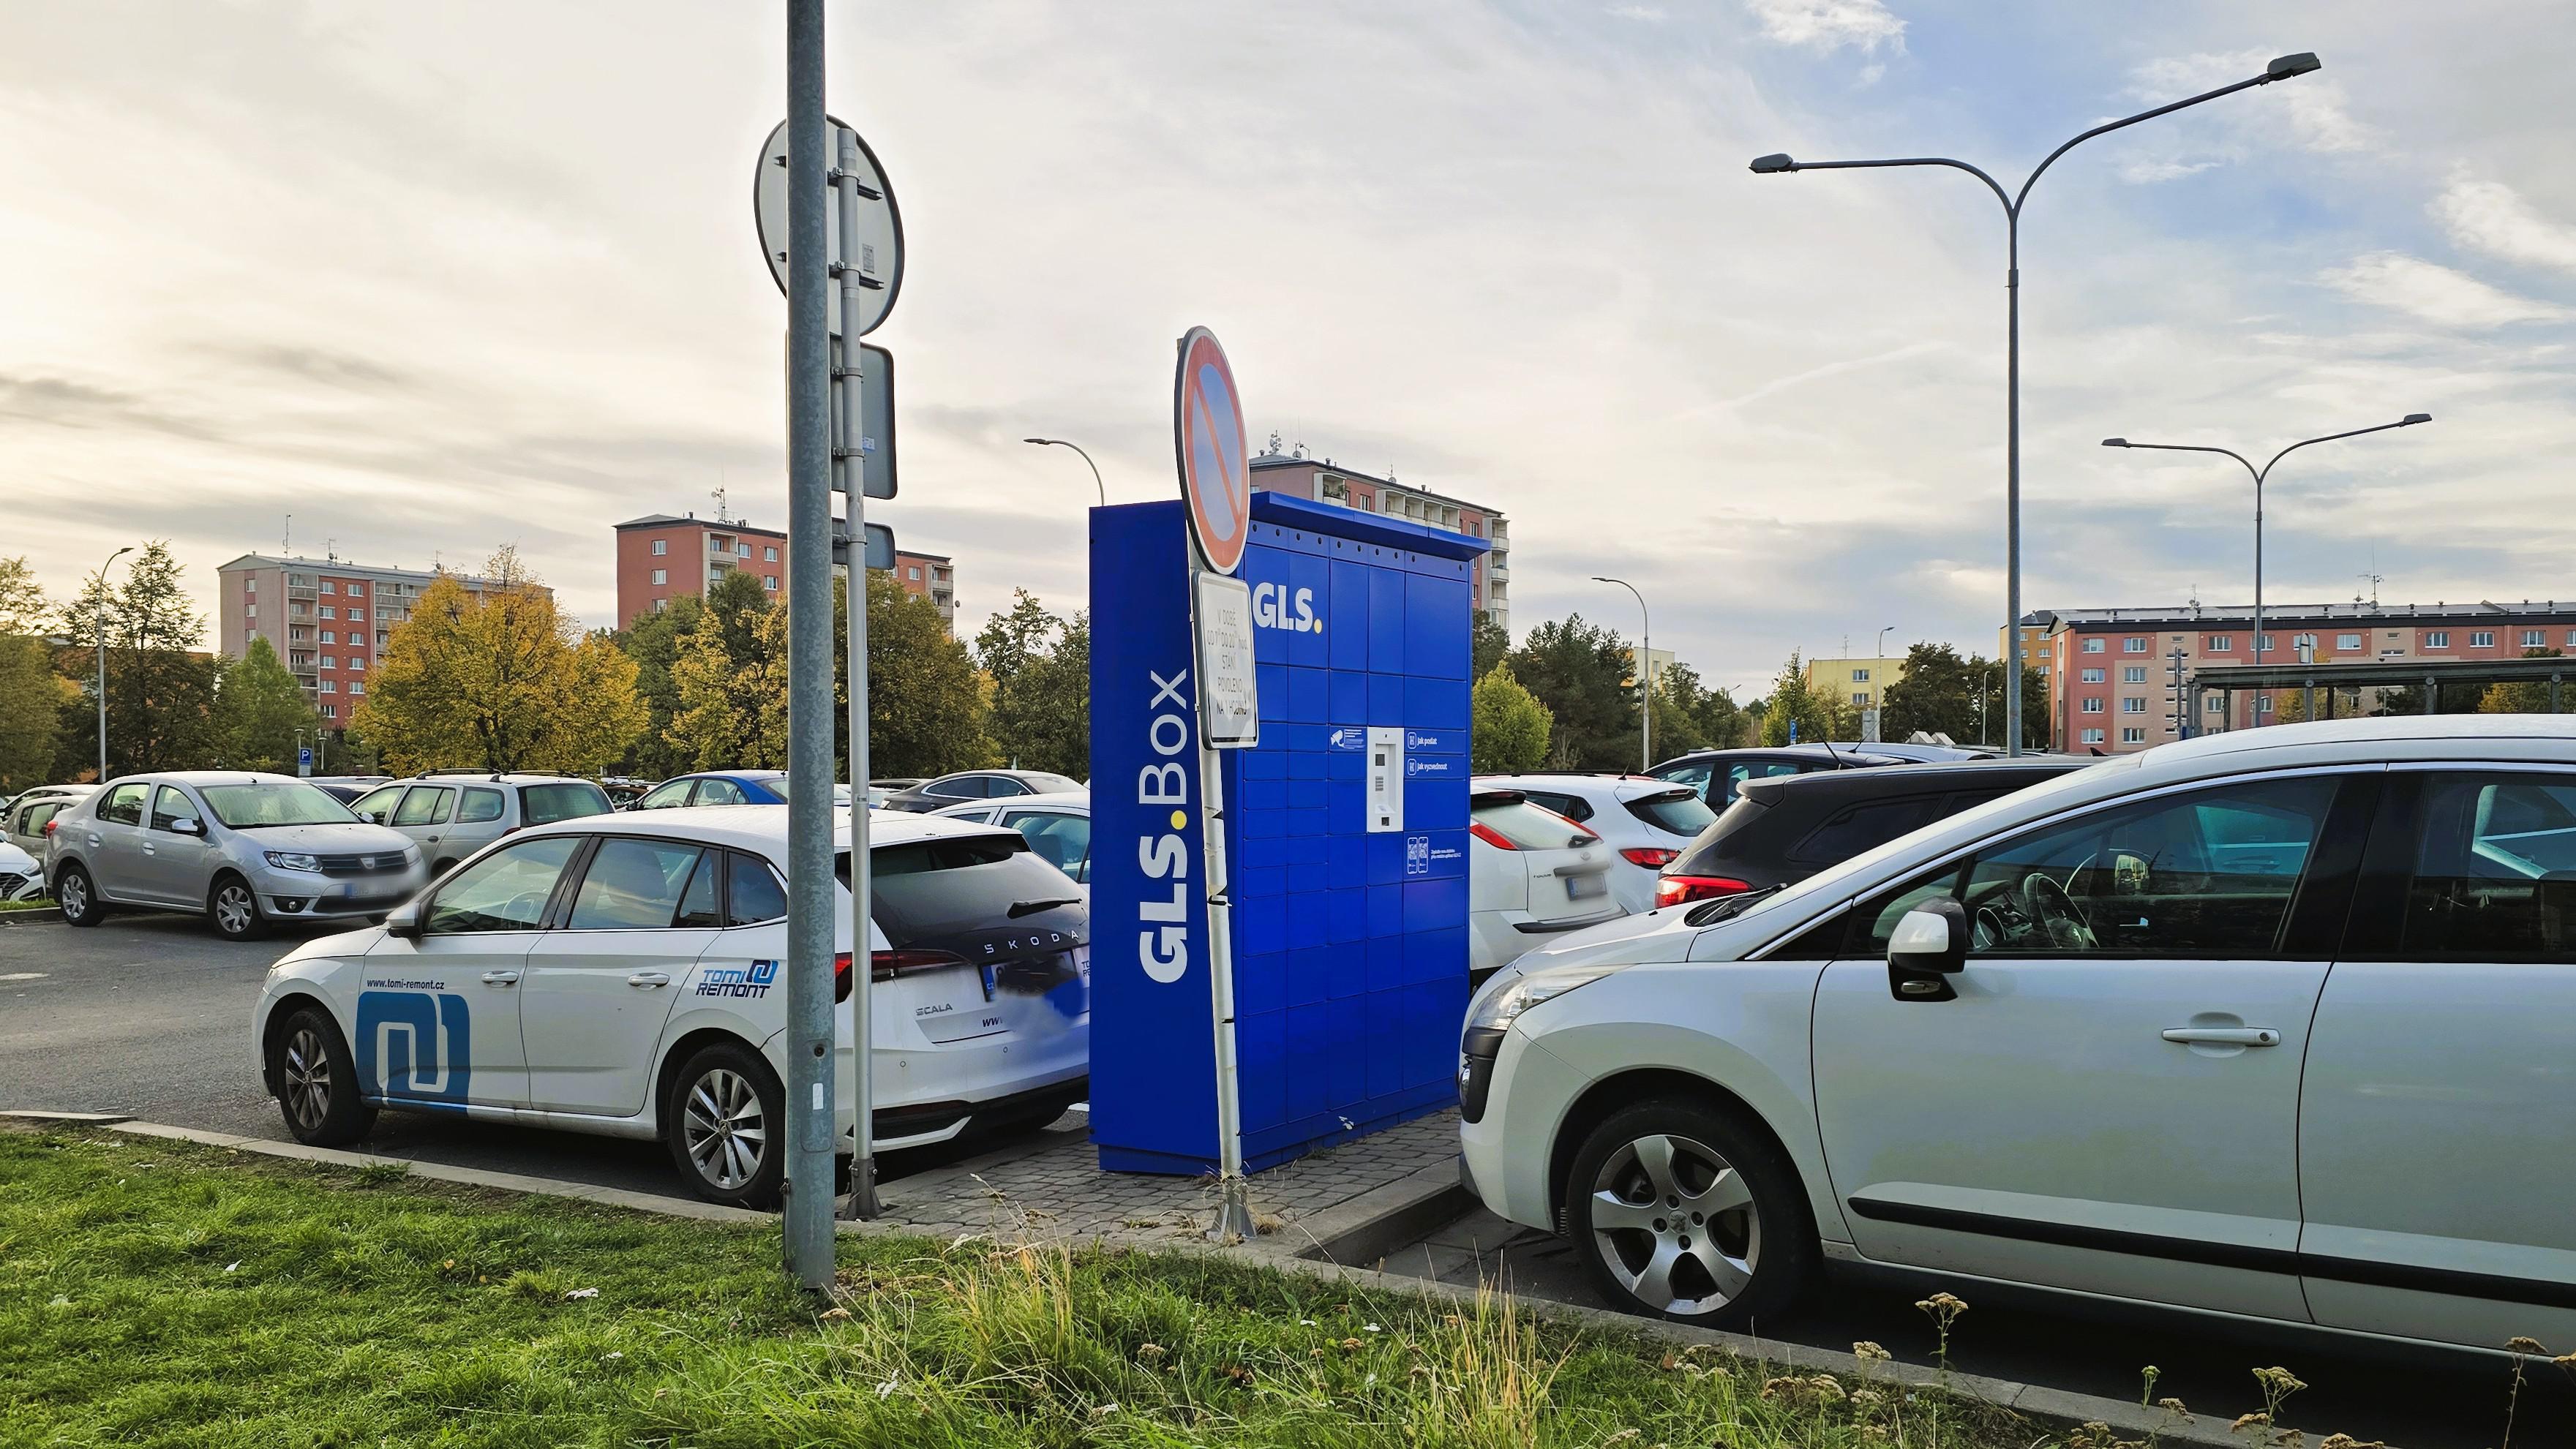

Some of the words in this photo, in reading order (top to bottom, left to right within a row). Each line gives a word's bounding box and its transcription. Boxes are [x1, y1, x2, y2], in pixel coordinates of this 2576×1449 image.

[1252, 582, 1323, 634] GLS.
[1217, 675, 1243, 693] POVOLENO
[1216, 699, 1225, 715] NA
[301, 750, 309, 760] P
[367, 978, 445, 990] www.tomi-remont.cz
[703, 970, 747, 984] TOMI
[696, 982, 771, 998] REMONT
[915, 1003, 953, 1016] SCALA
